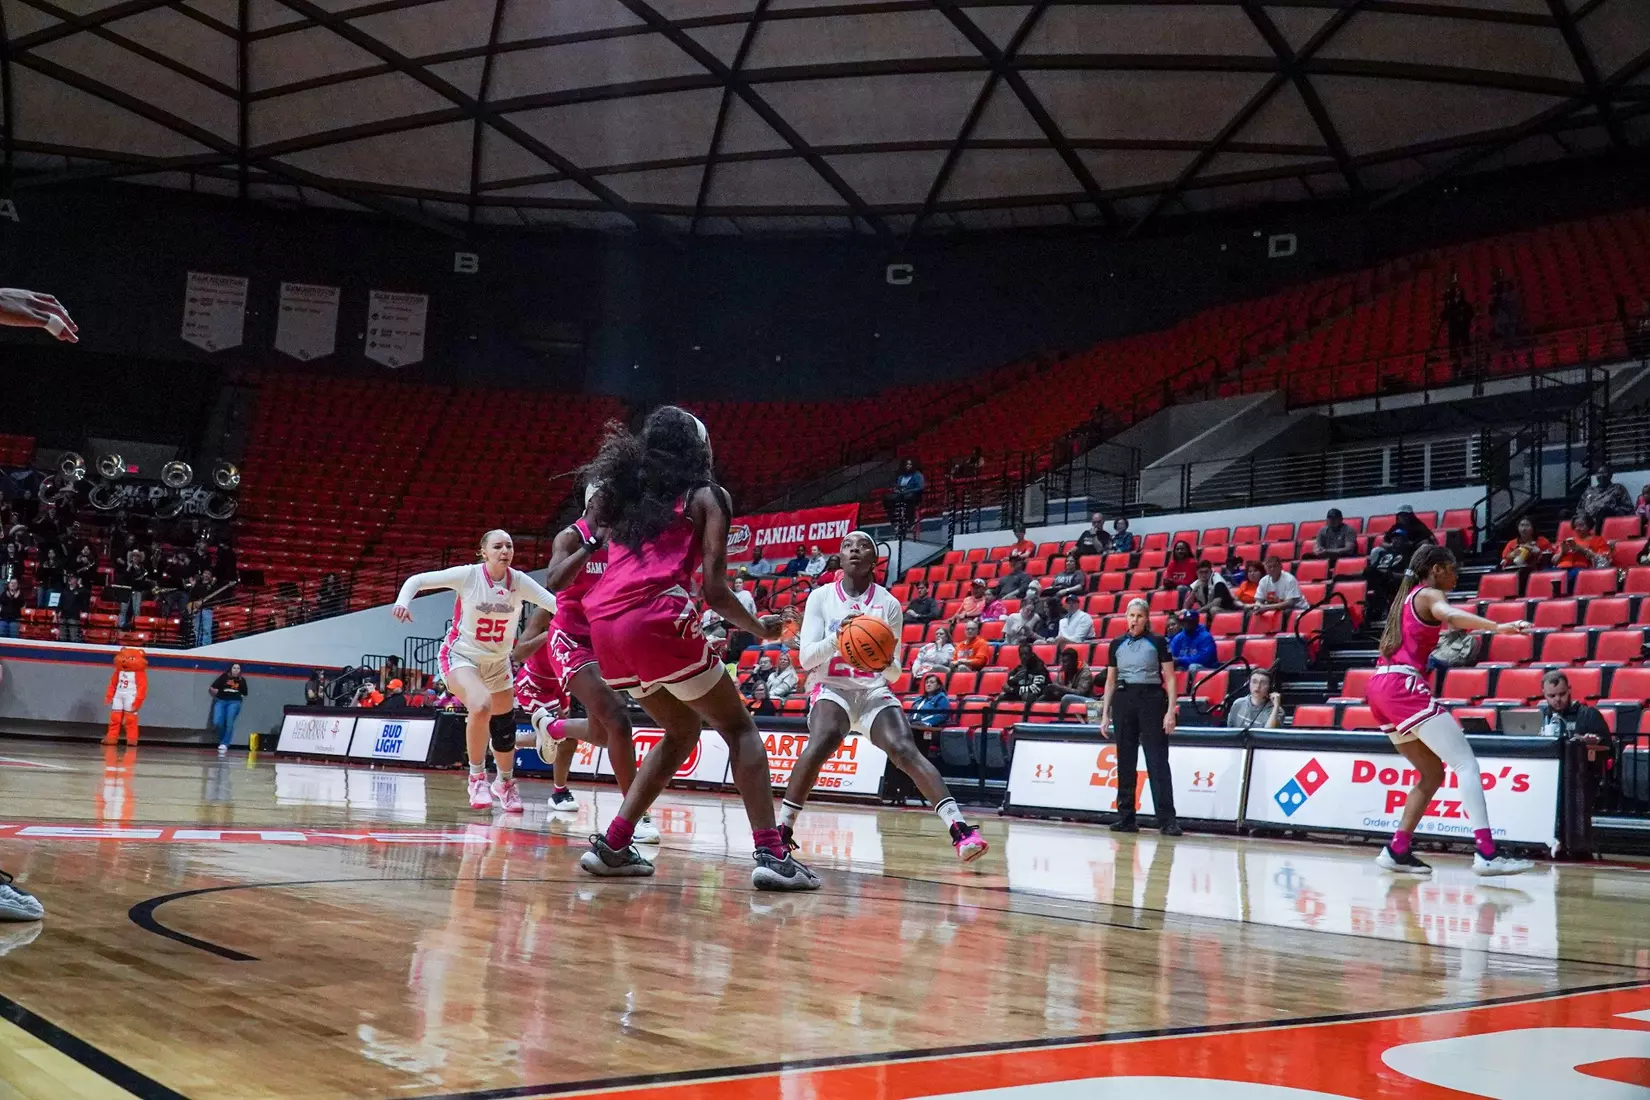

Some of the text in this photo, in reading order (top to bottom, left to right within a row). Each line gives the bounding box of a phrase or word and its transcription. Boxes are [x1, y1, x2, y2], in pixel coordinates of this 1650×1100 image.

[1268, 233, 1297, 258] D
[454, 252, 479, 273] B
[886, 263, 914, 285] C
[755, 519, 850, 546] CANIAC CREW
[476, 617, 509, 642] 25
[381, 724, 403, 739] BUD
[374, 739, 404, 754] LIGHT
[1351, 760, 1529, 793] Domo's
[1363, 817, 1391, 828] Order
